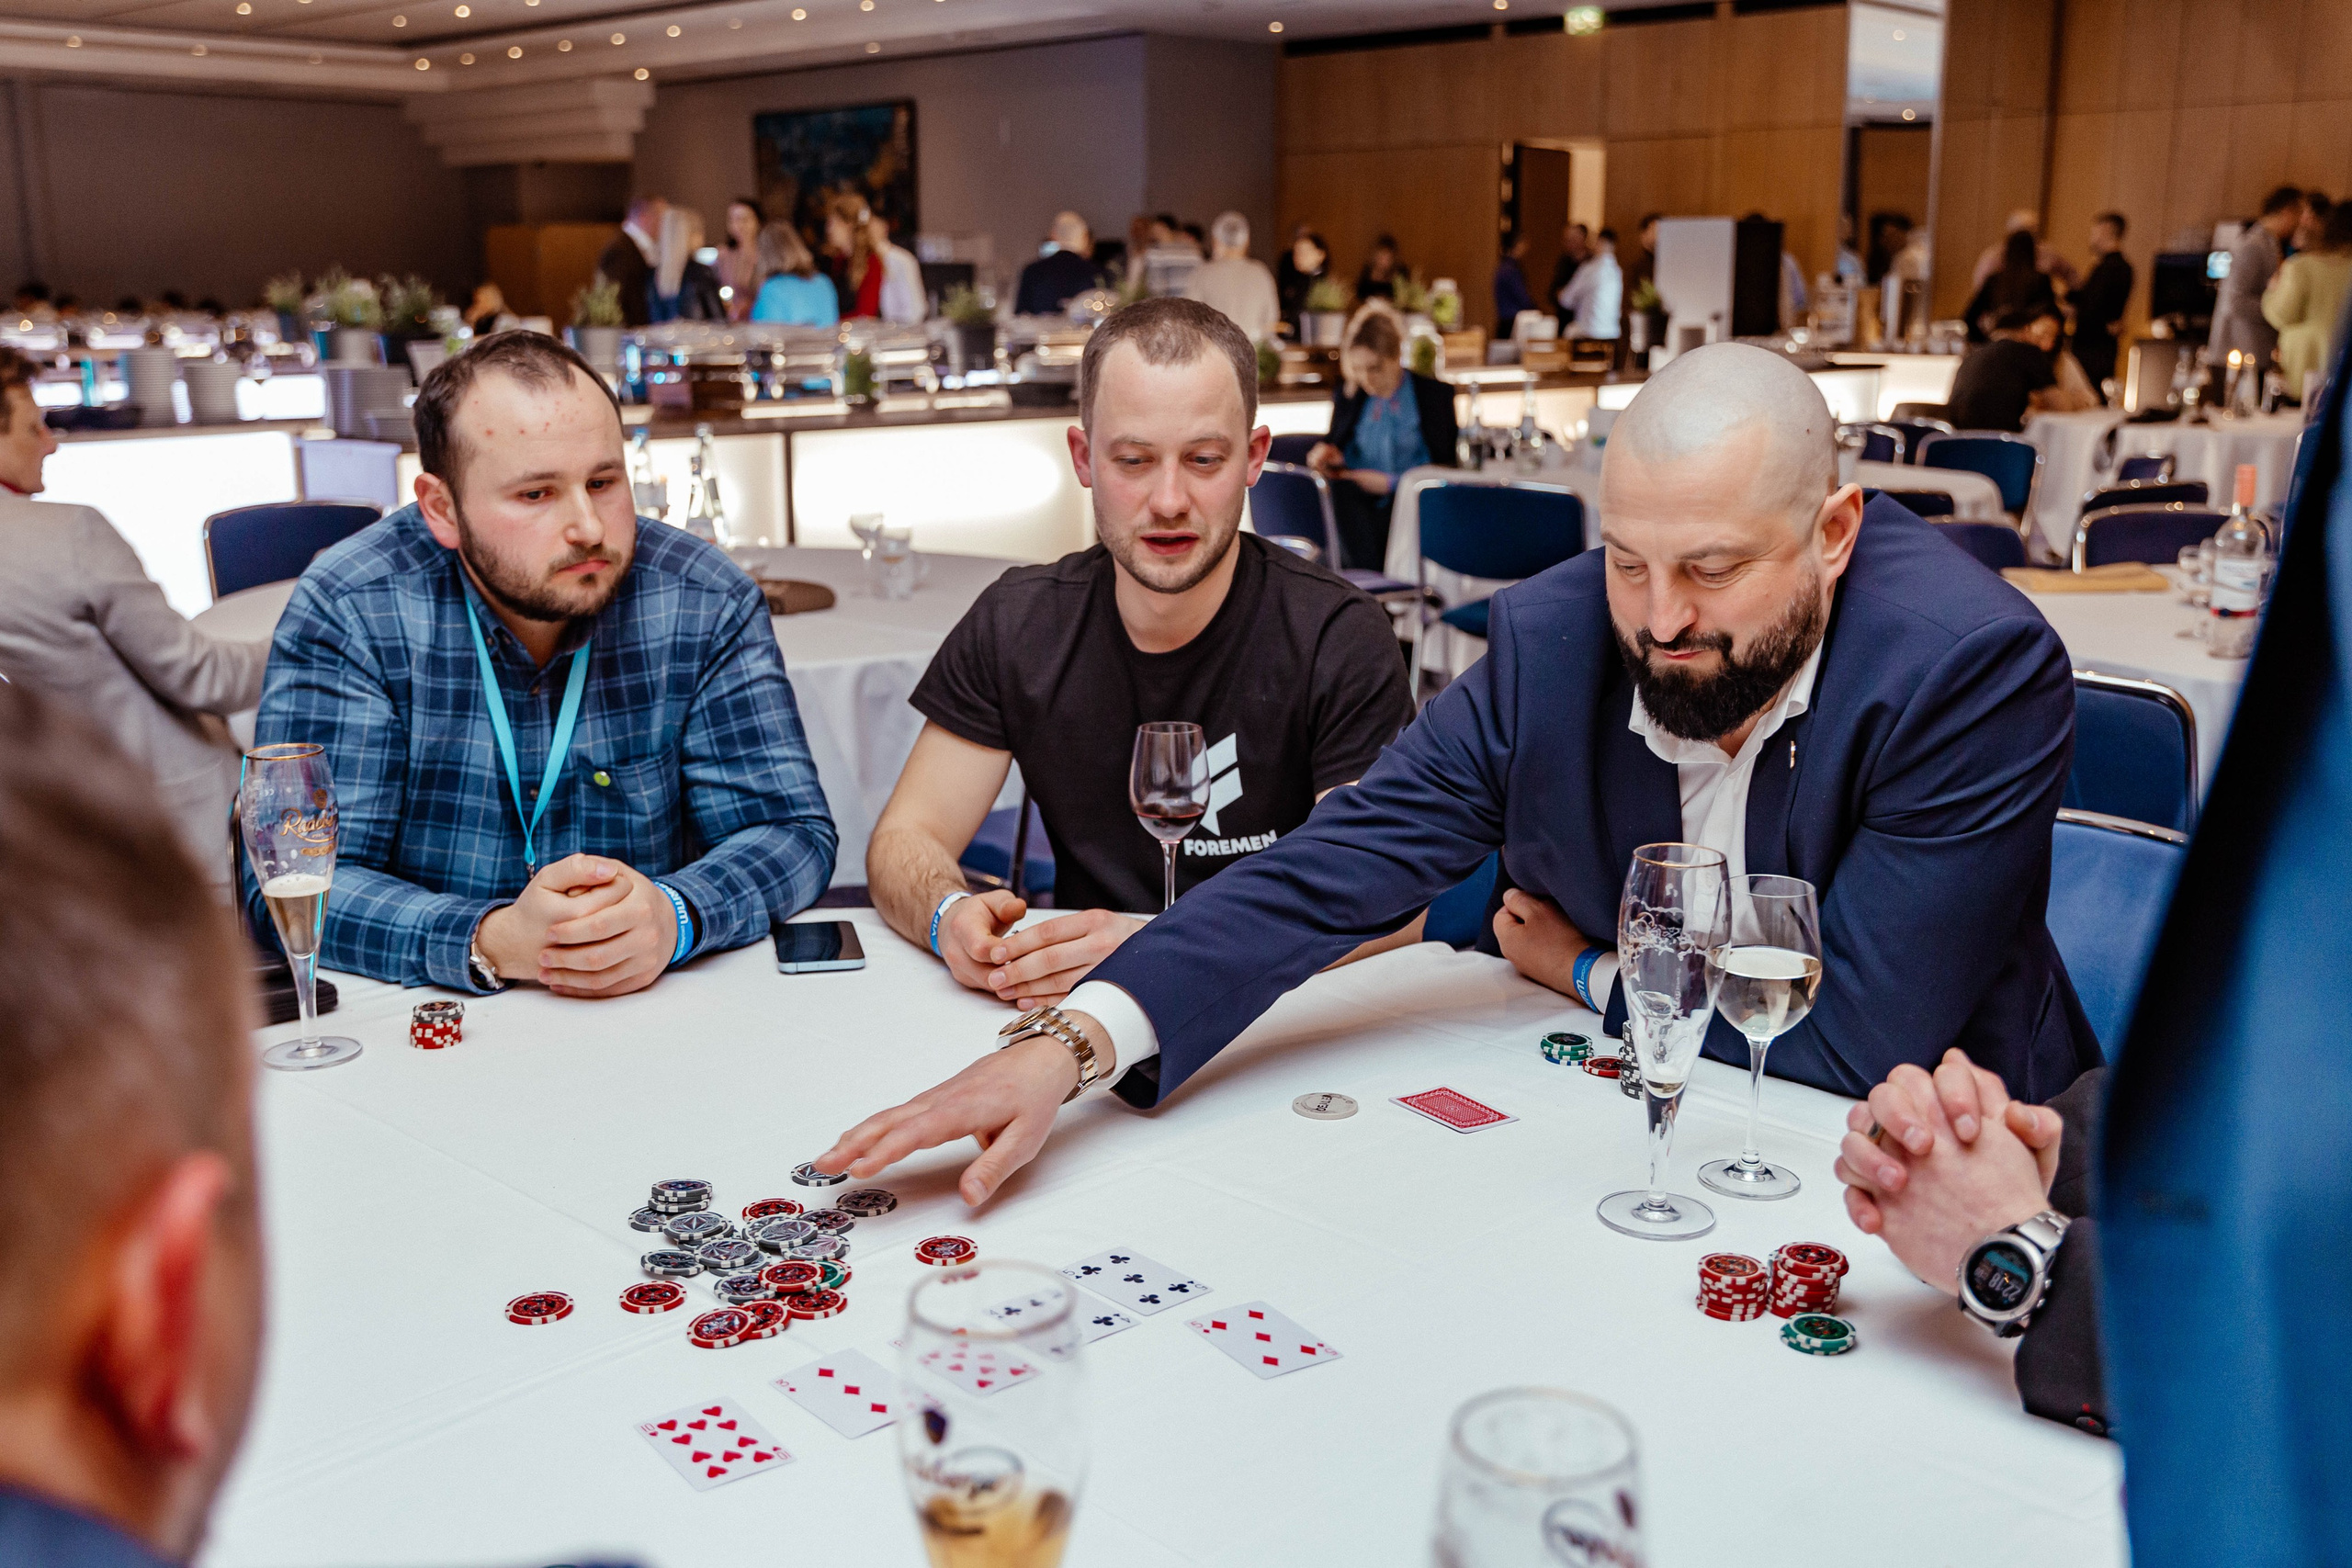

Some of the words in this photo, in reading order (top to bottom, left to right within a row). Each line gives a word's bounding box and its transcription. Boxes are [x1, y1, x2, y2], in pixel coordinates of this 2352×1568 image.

[1183, 829, 1278, 856] FOREMEN
[1062, 1269, 1076, 1277] 5
[1191, 1320, 1204, 1328] 5
[1324, 1348, 1339, 1356] 5
[640, 1423, 656, 1433] 10
